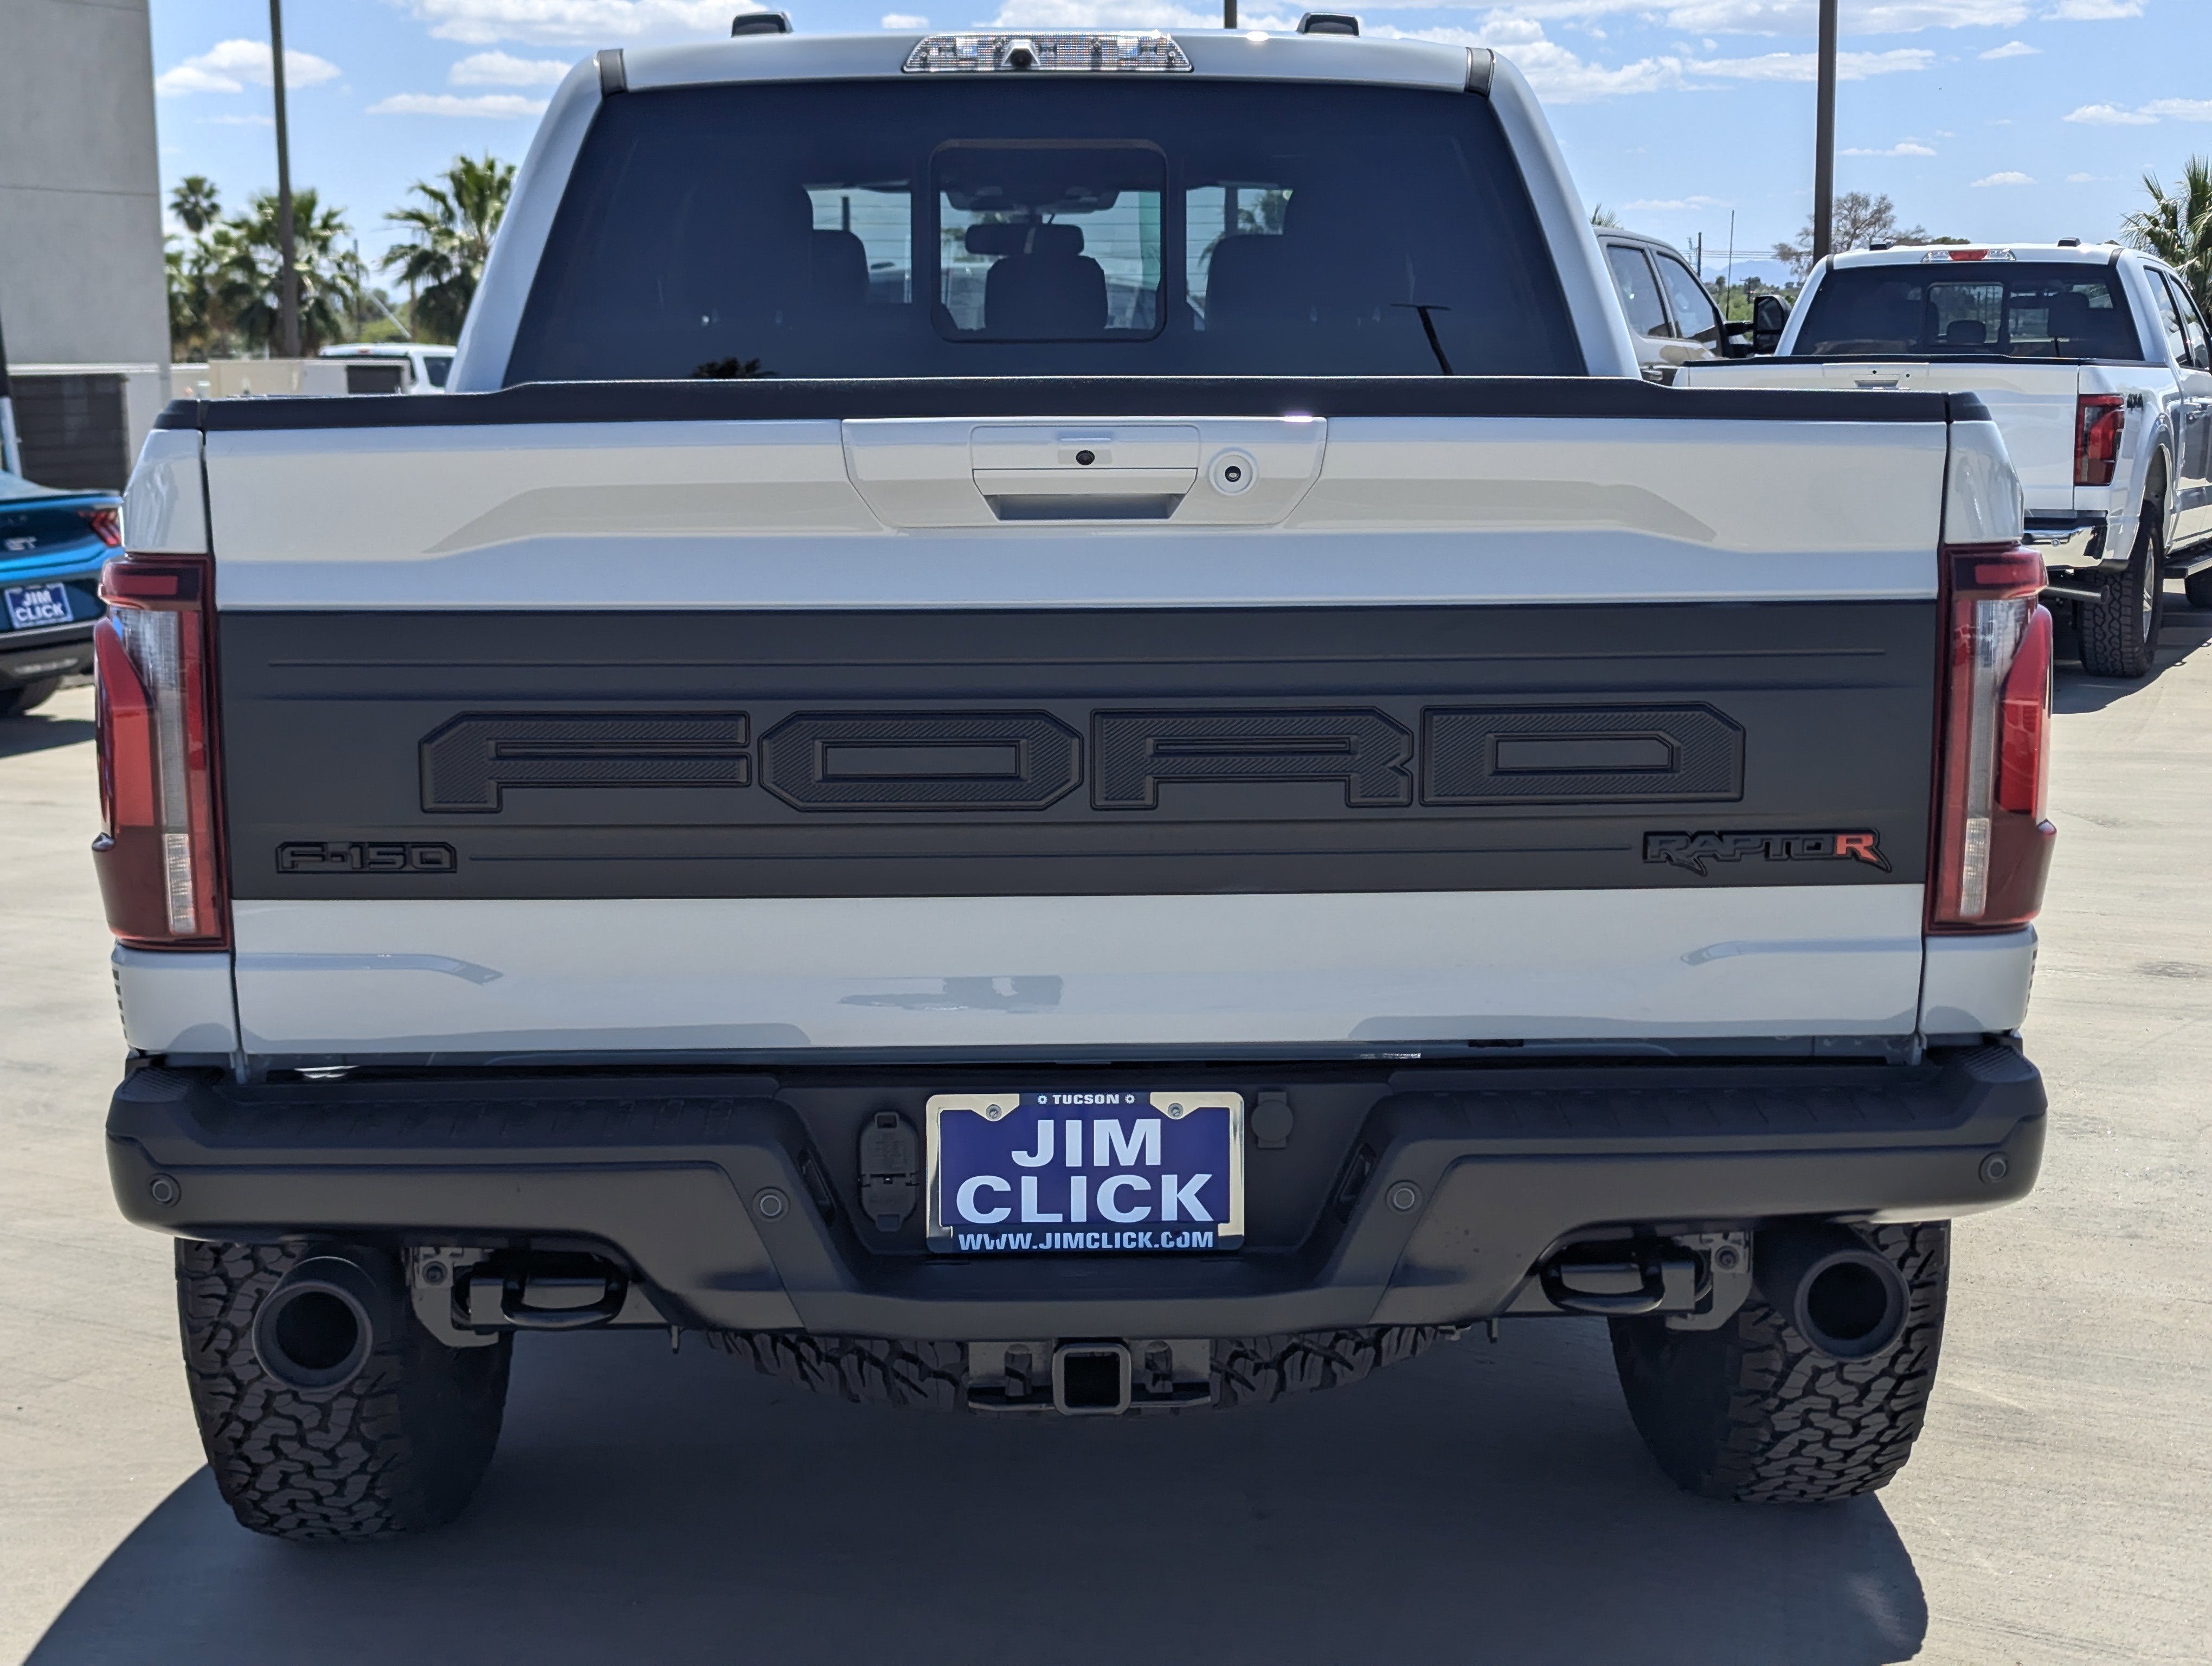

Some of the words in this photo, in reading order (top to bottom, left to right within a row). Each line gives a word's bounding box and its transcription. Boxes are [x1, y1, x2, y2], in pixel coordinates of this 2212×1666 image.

[15, 602, 65, 621] CLICK
[22, 590, 53, 606] JIM
[419, 701, 1745, 812] FORD
[278, 842, 457, 873] F-150
[1644, 830, 1892, 876] RAPTOR
[1052, 1094, 1120, 1105] TUCSON
[1011, 1118, 1161, 1168] JIM
[956, 1173, 1214, 1223] CLICK
[959, 1231, 1214, 1251] WWW.JIMCLICK.COM
